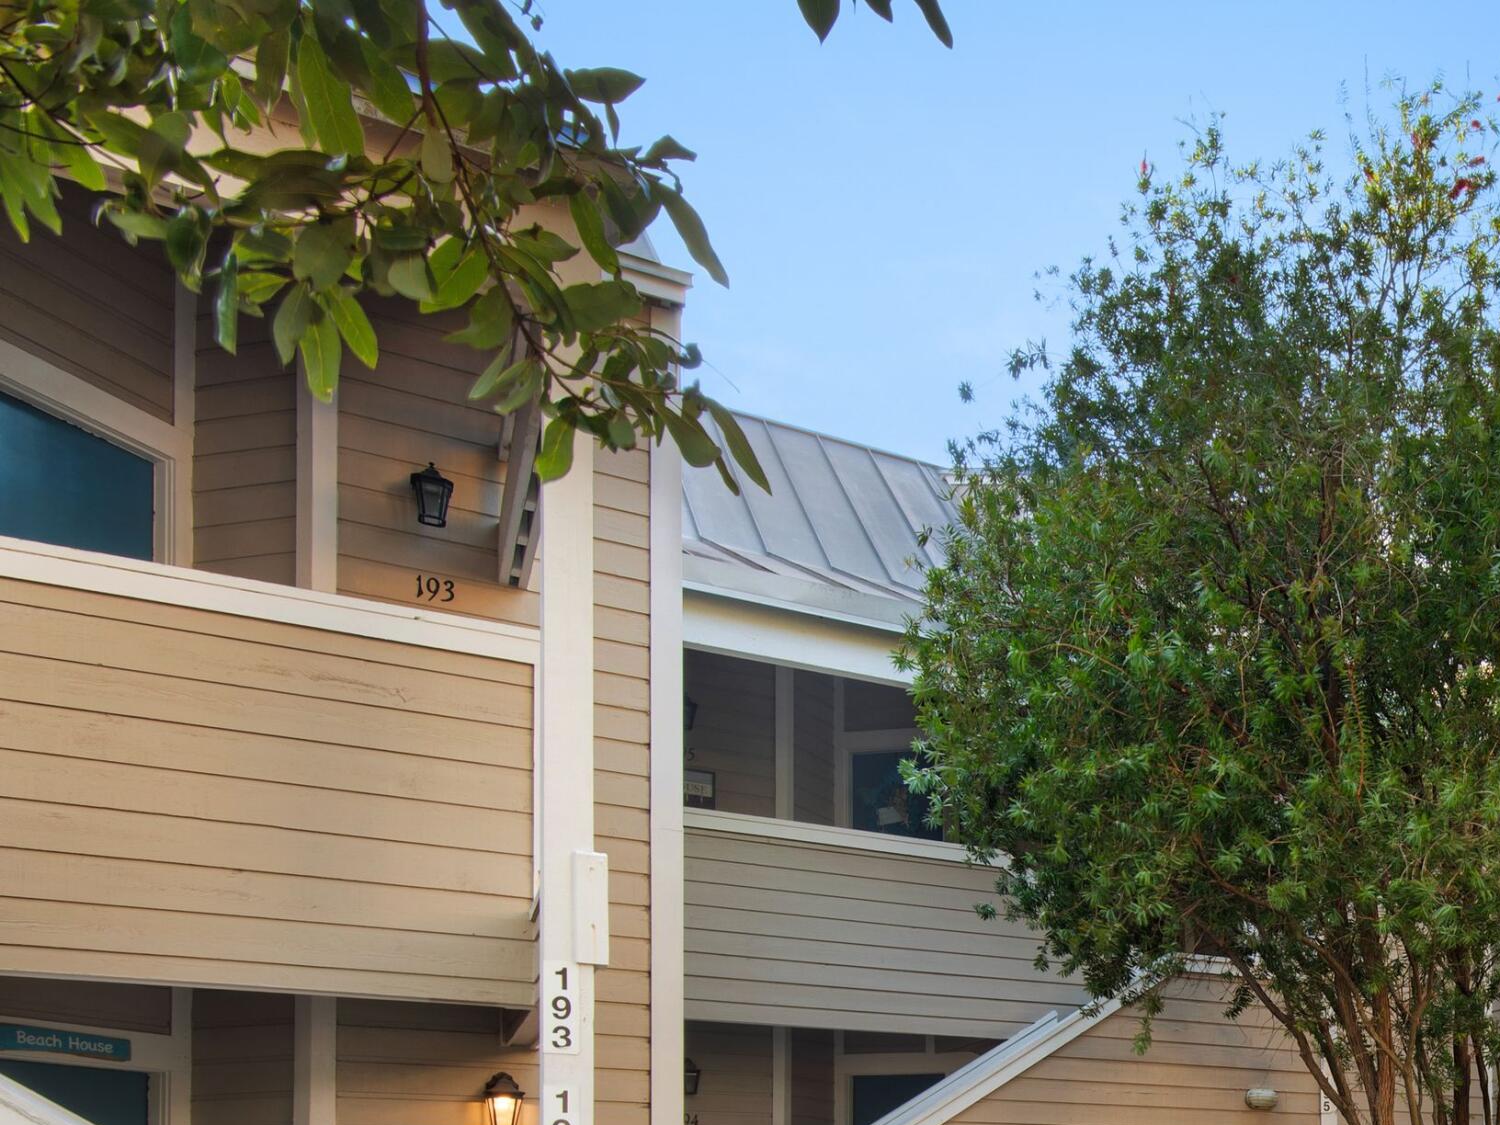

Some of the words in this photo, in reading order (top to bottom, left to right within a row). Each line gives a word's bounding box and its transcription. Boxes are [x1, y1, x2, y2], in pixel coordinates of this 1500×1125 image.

[415, 574, 455, 602] 193
[551, 966, 572, 1049] 193
[16, 1030, 63, 1049] Beach
[68, 1036, 113, 1054] House
